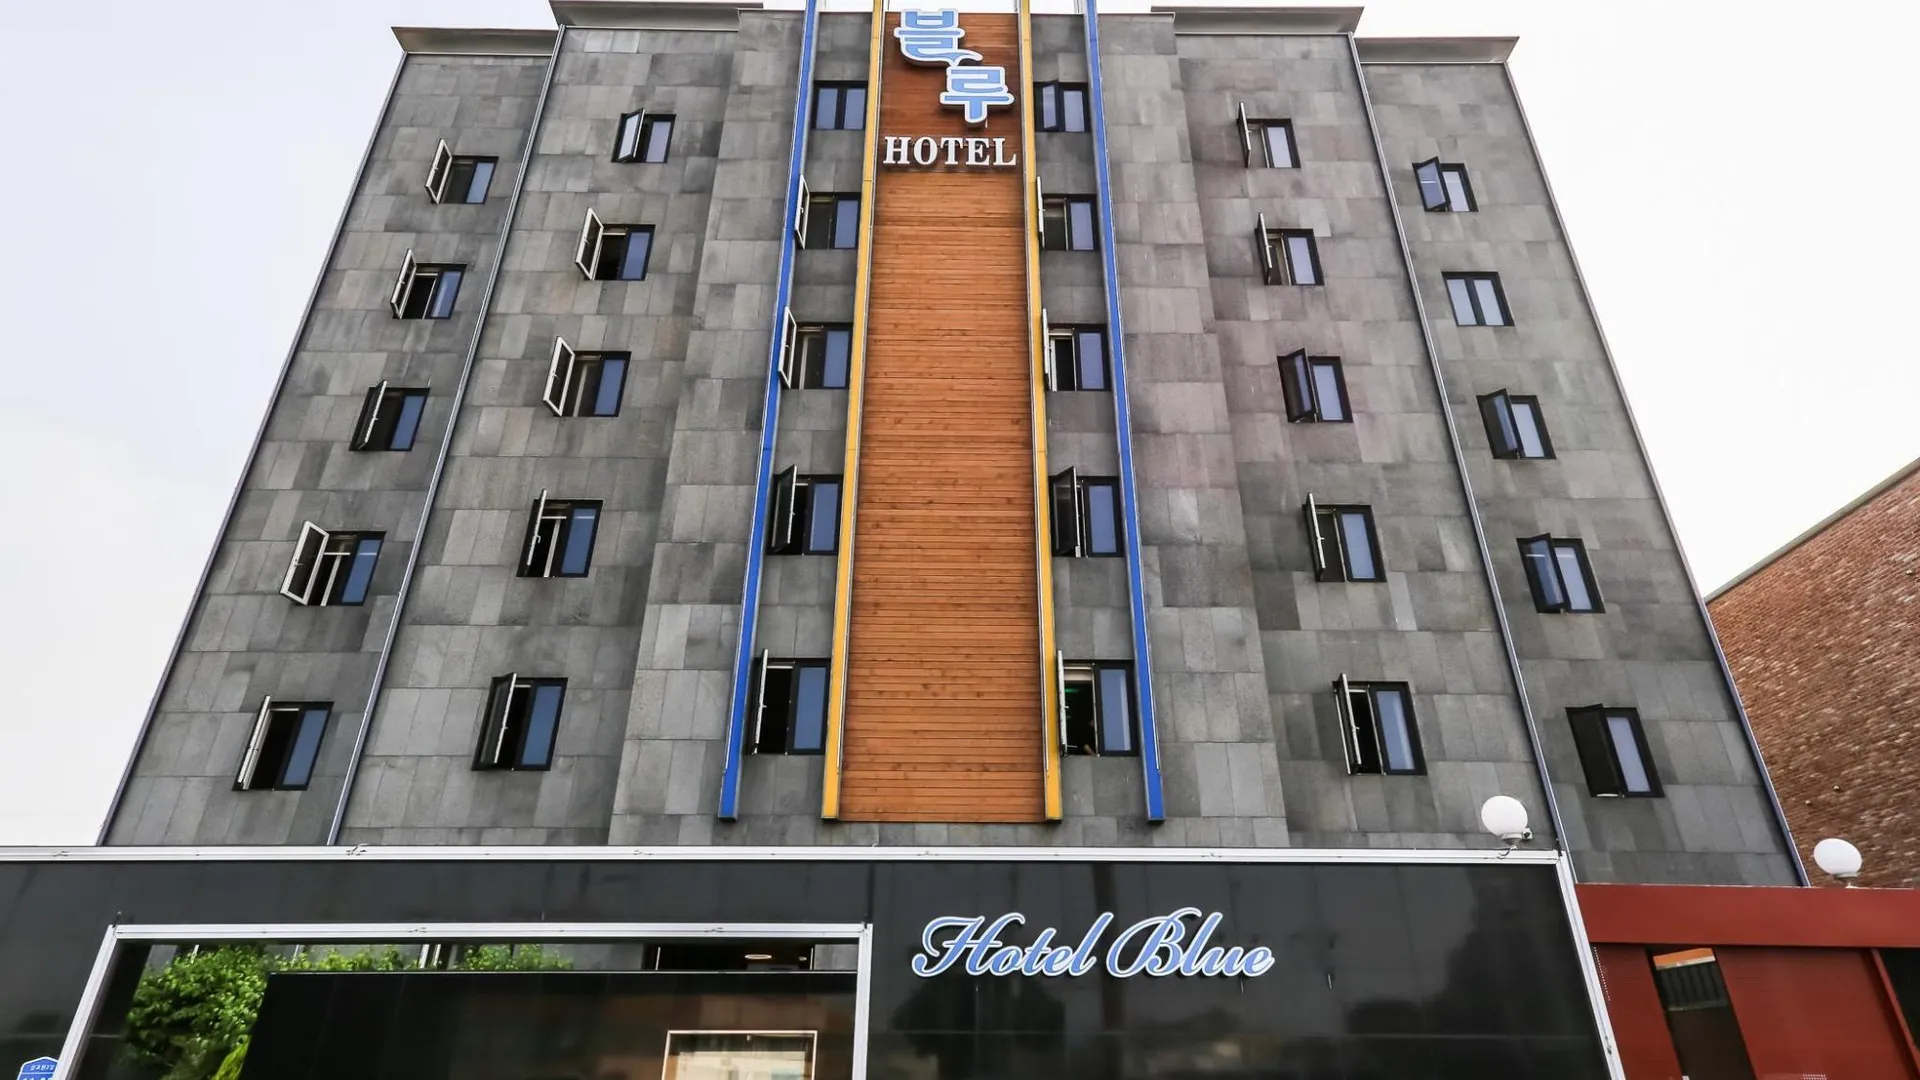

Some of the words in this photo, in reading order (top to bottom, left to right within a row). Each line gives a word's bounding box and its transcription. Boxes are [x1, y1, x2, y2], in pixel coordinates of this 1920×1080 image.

[894, 9, 1015, 123] 블루
[883, 136, 1017, 166] HOTEL
[911, 912, 1114, 977] Hotel
[1106, 907, 1275, 977] Blue
